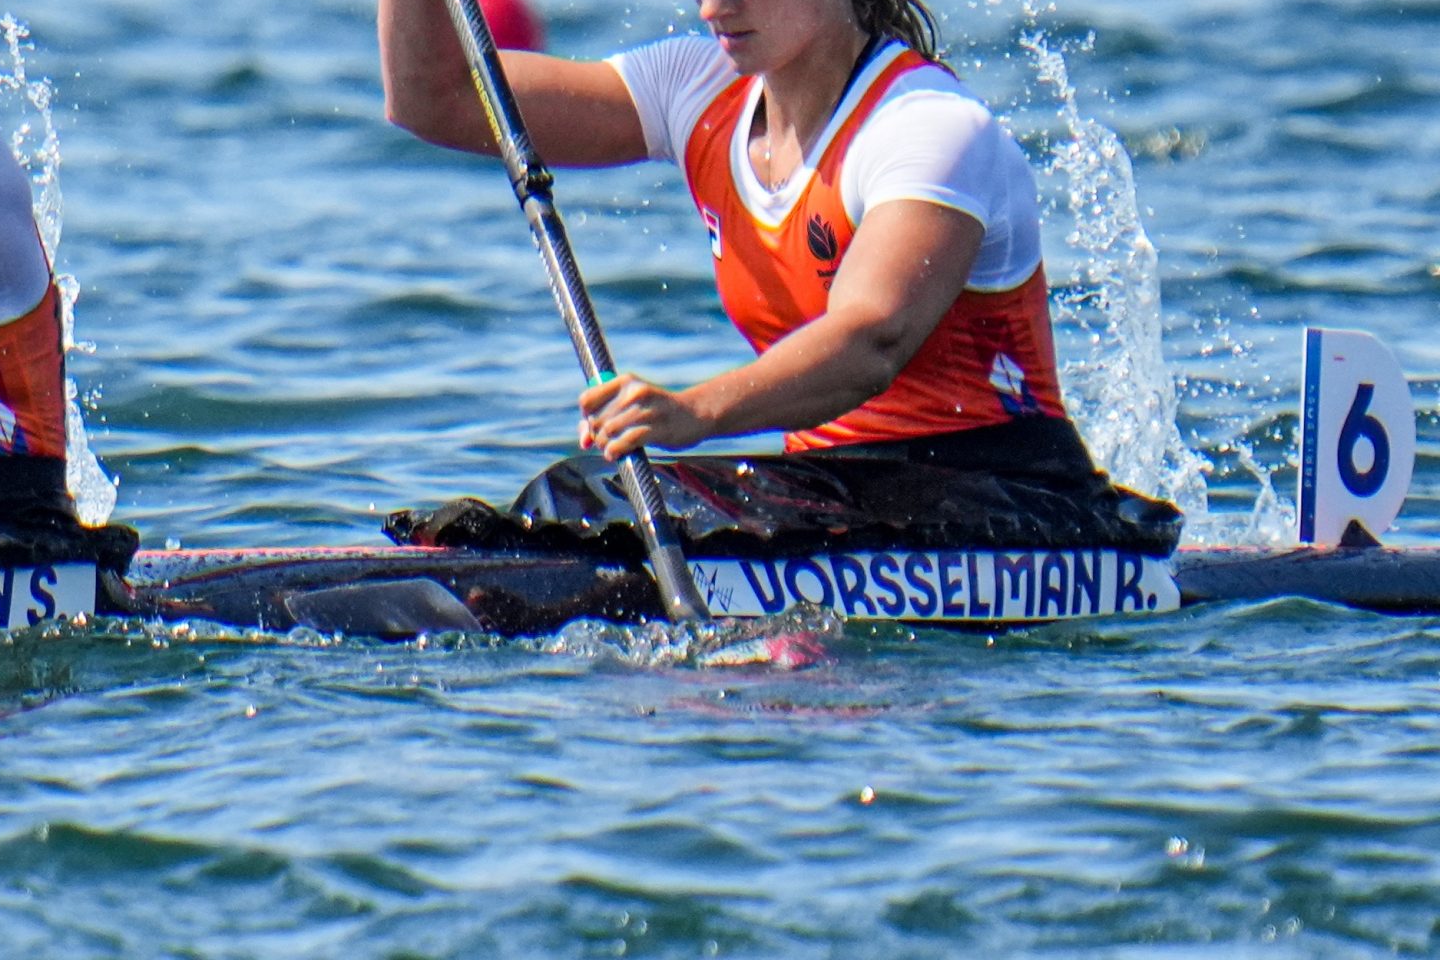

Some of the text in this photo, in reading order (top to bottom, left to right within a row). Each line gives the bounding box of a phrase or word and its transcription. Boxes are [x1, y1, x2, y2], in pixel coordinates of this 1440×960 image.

[1337, 383, 1390, 498] 6
[739, 549, 1157, 617] VORSSELMAN R.
